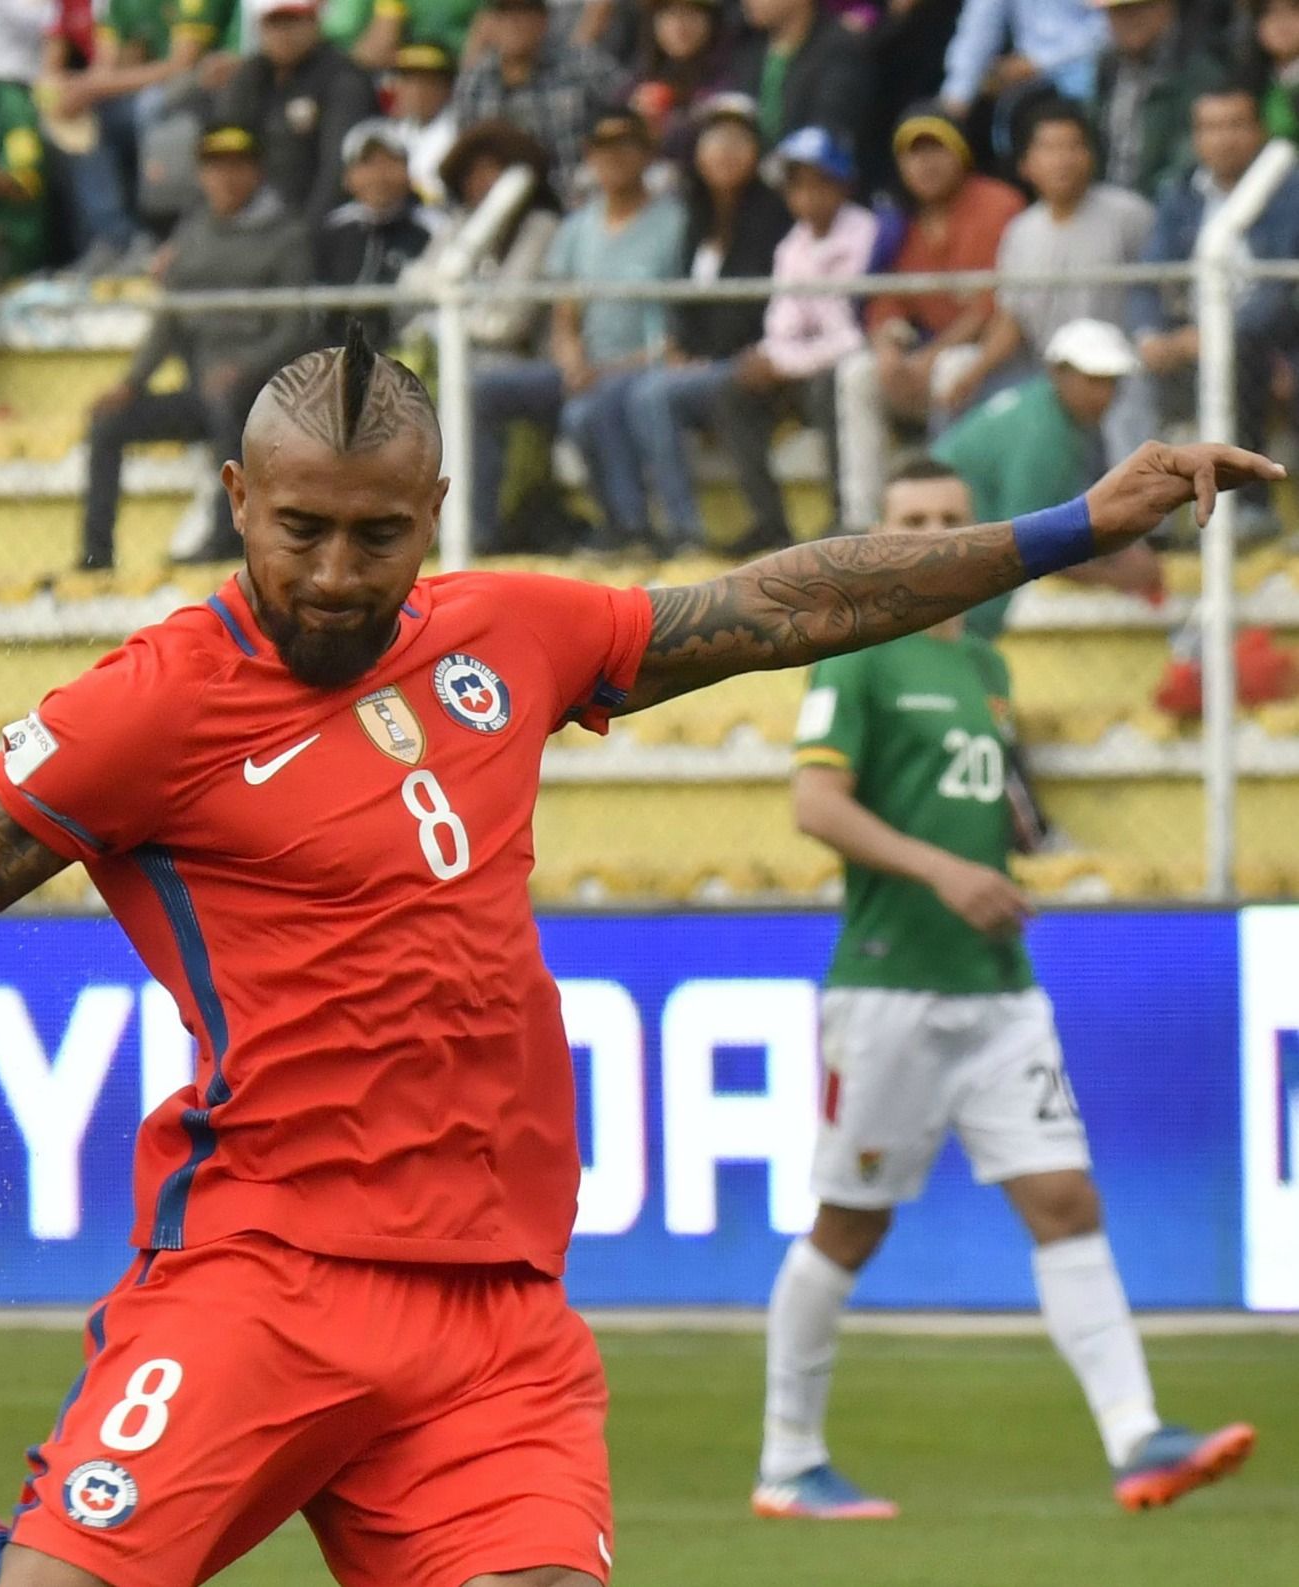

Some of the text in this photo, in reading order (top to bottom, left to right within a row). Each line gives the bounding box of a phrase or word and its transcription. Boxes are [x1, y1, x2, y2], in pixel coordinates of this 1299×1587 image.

[937, 728, 1005, 803] 20
[401, 769, 470, 881] 8
[99, 1358, 184, 1452] 8
